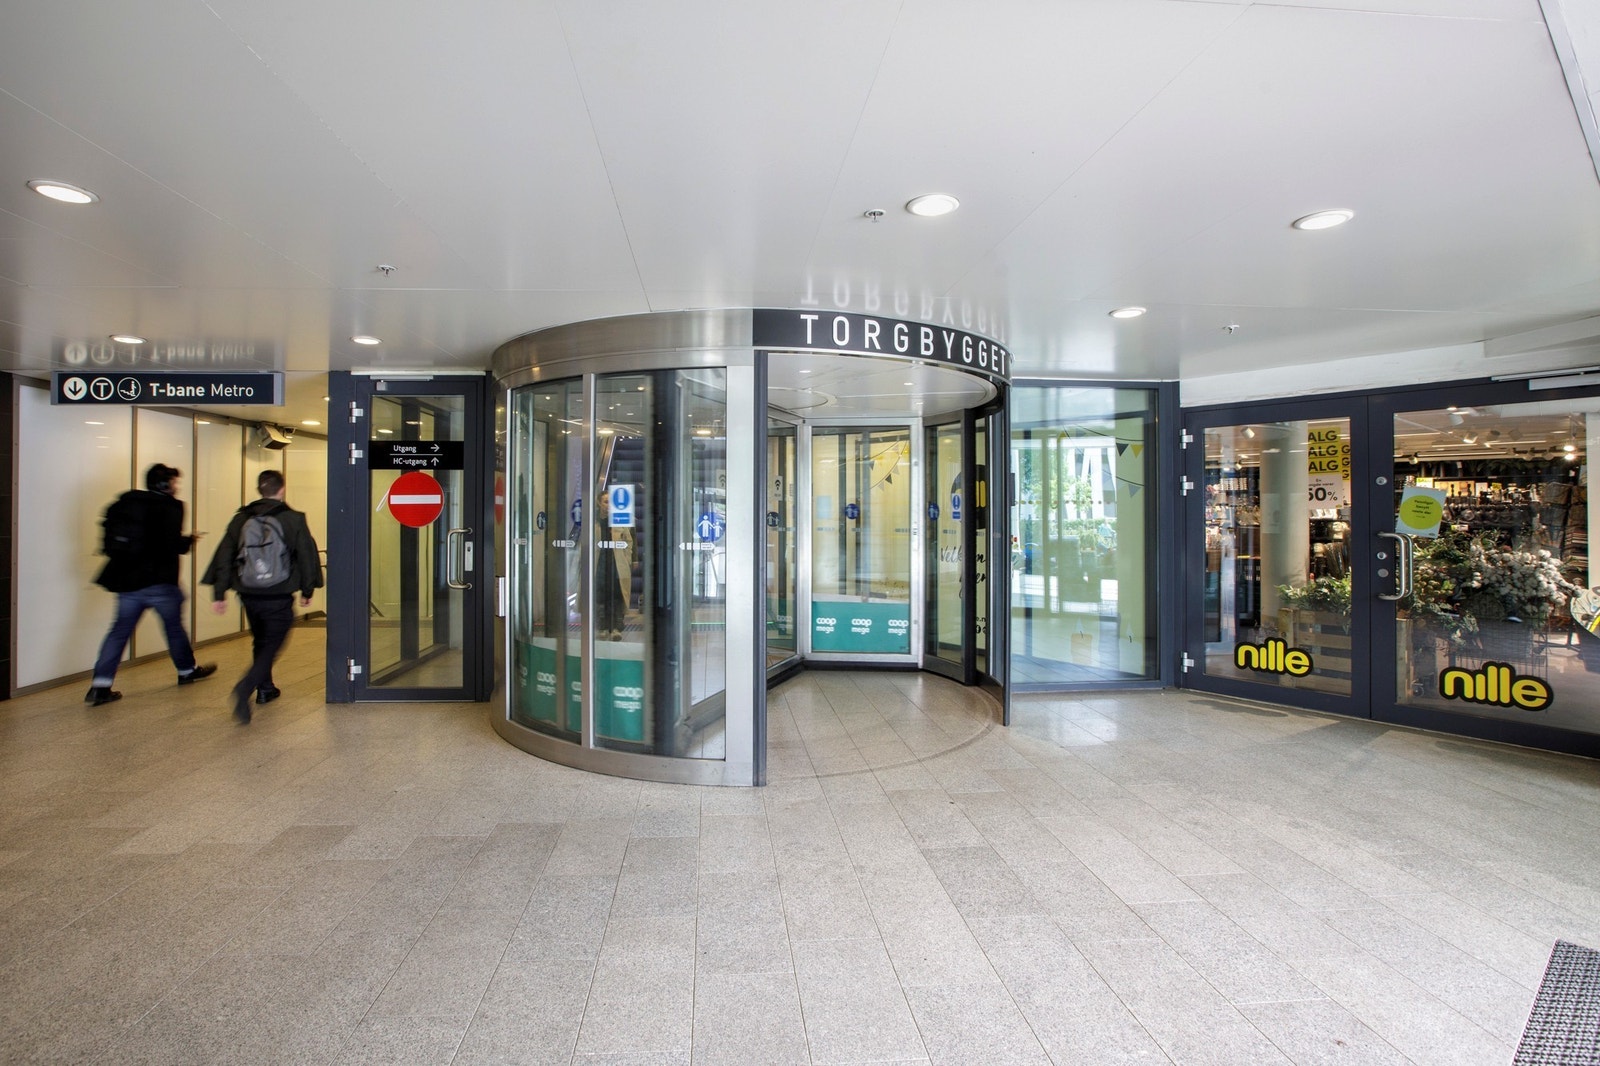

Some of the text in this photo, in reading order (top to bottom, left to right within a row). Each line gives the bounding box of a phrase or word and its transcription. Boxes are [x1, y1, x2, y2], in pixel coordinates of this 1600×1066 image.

[800, 314, 1006, 375] TORGBYGGET
[149, 383, 205, 397] T-bane
[211, 384, 254, 397] Metro
[1308, 430, 1337, 442] ALG
[393, 445, 417, 453] Utgang
[1308, 445, 1338, 457] ALG
[393, 458, 427, 466] HC-utgang
[1308, 460, 1338, 472] ALG
[816, 617, 837, 626] coop
[851, 618, 872, 627] coop
[888, 619, 909, 628] coop
[816, 626, 834, 634] mega
[851, 627, 870, 635] mega
[888, 628, 906, 636] mega
[1236, 639, 1311, 676] nille
[1442, 663, 1550, 709] nille
